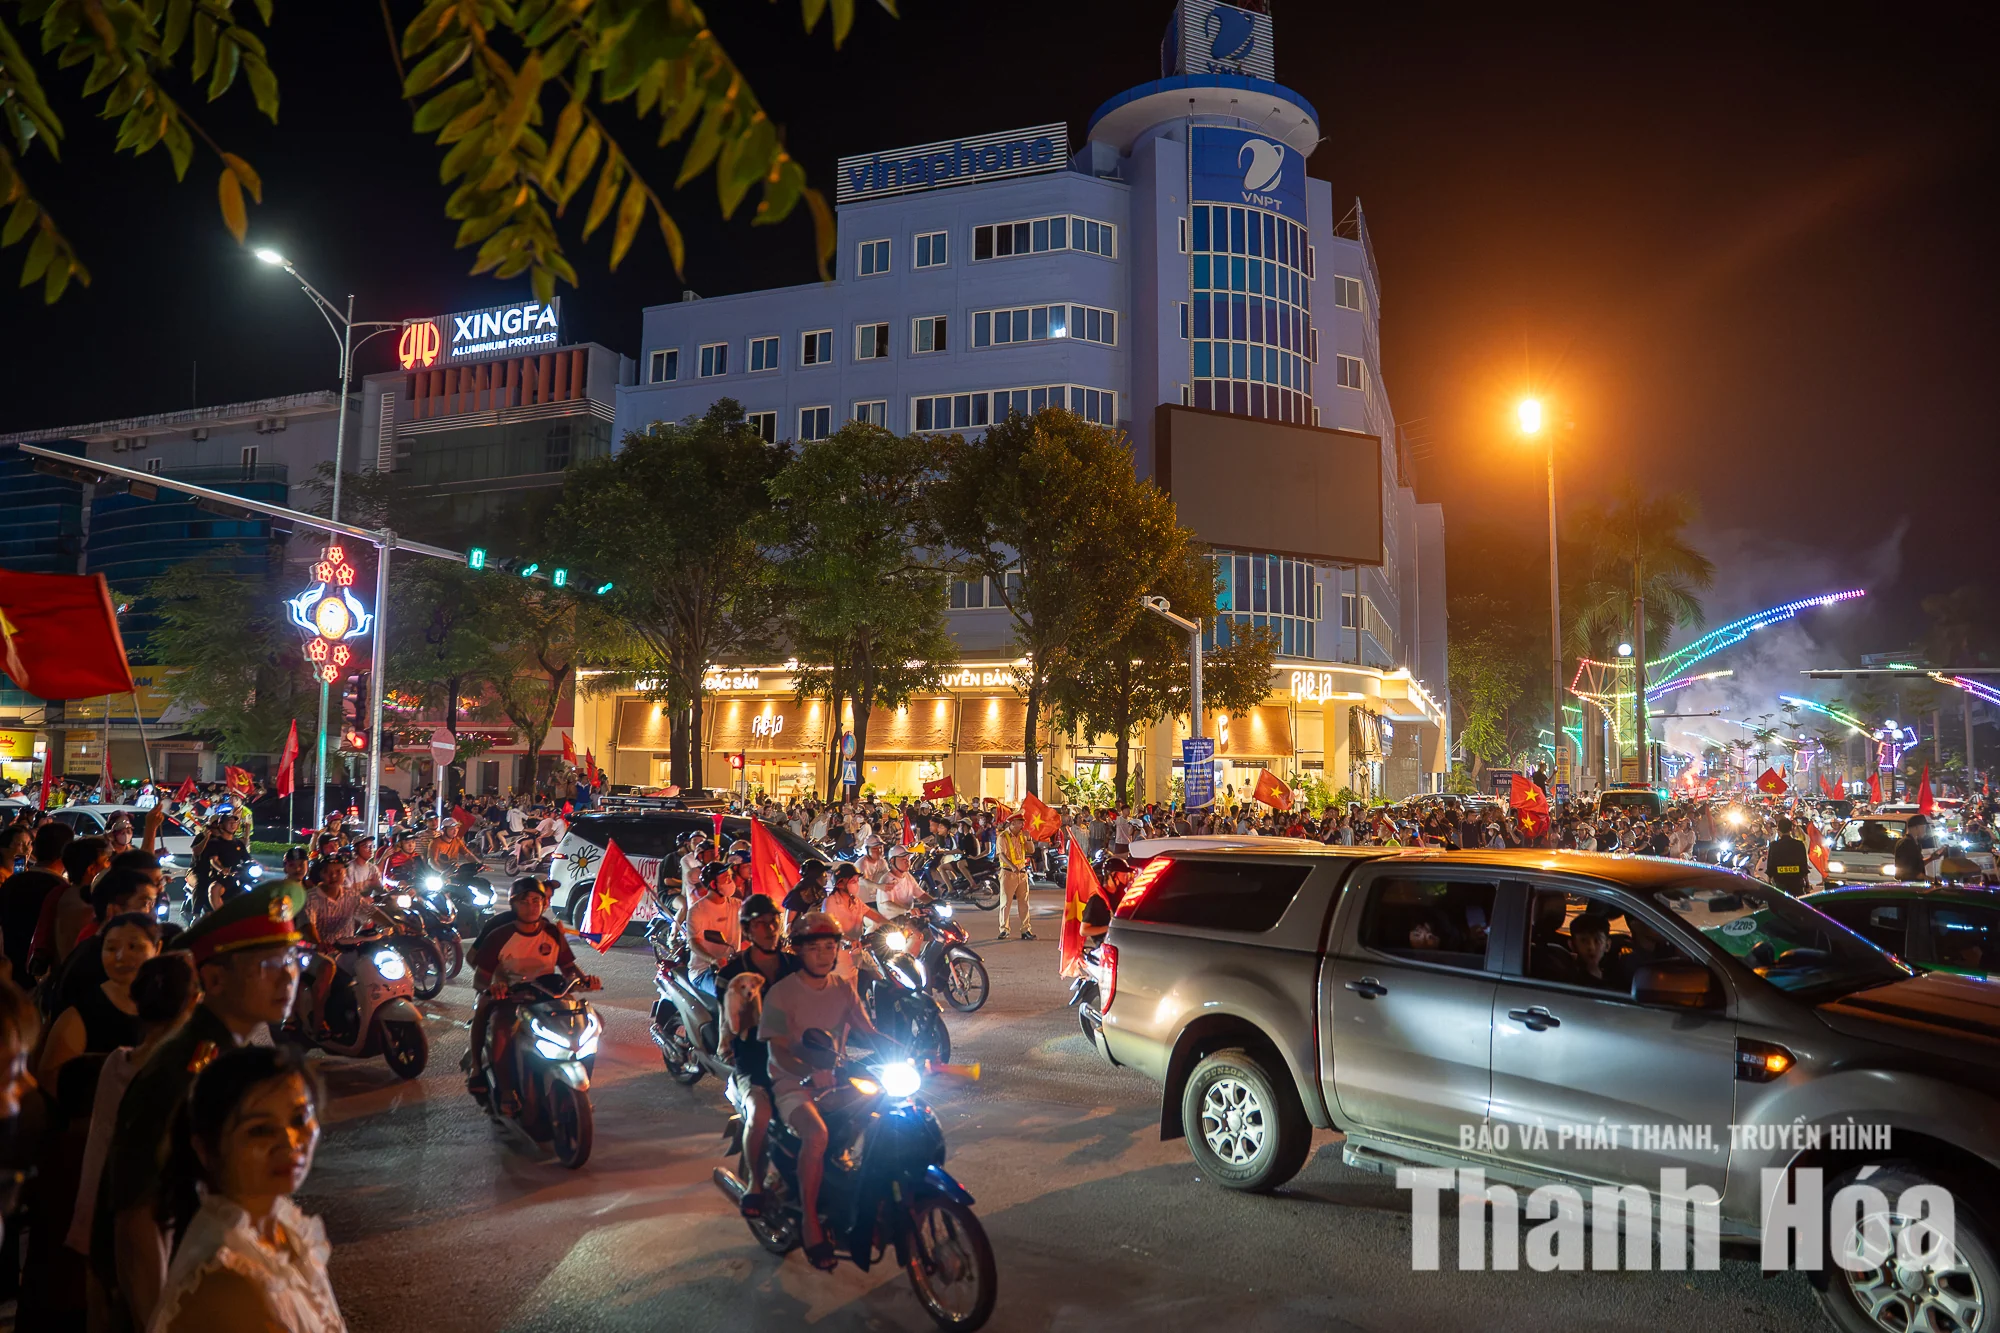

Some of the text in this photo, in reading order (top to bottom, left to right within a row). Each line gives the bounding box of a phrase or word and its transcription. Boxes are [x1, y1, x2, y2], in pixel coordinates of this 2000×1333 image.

[848, 137, 1054, 192] vinaphone
[1241, 191, 1283, 211] VNPT
[452, 304, 558, 342] XINGFA
[452, 332, 557, 357] ALUMINIUM PROFILES
[733, 673, 759, 690] SẢN
